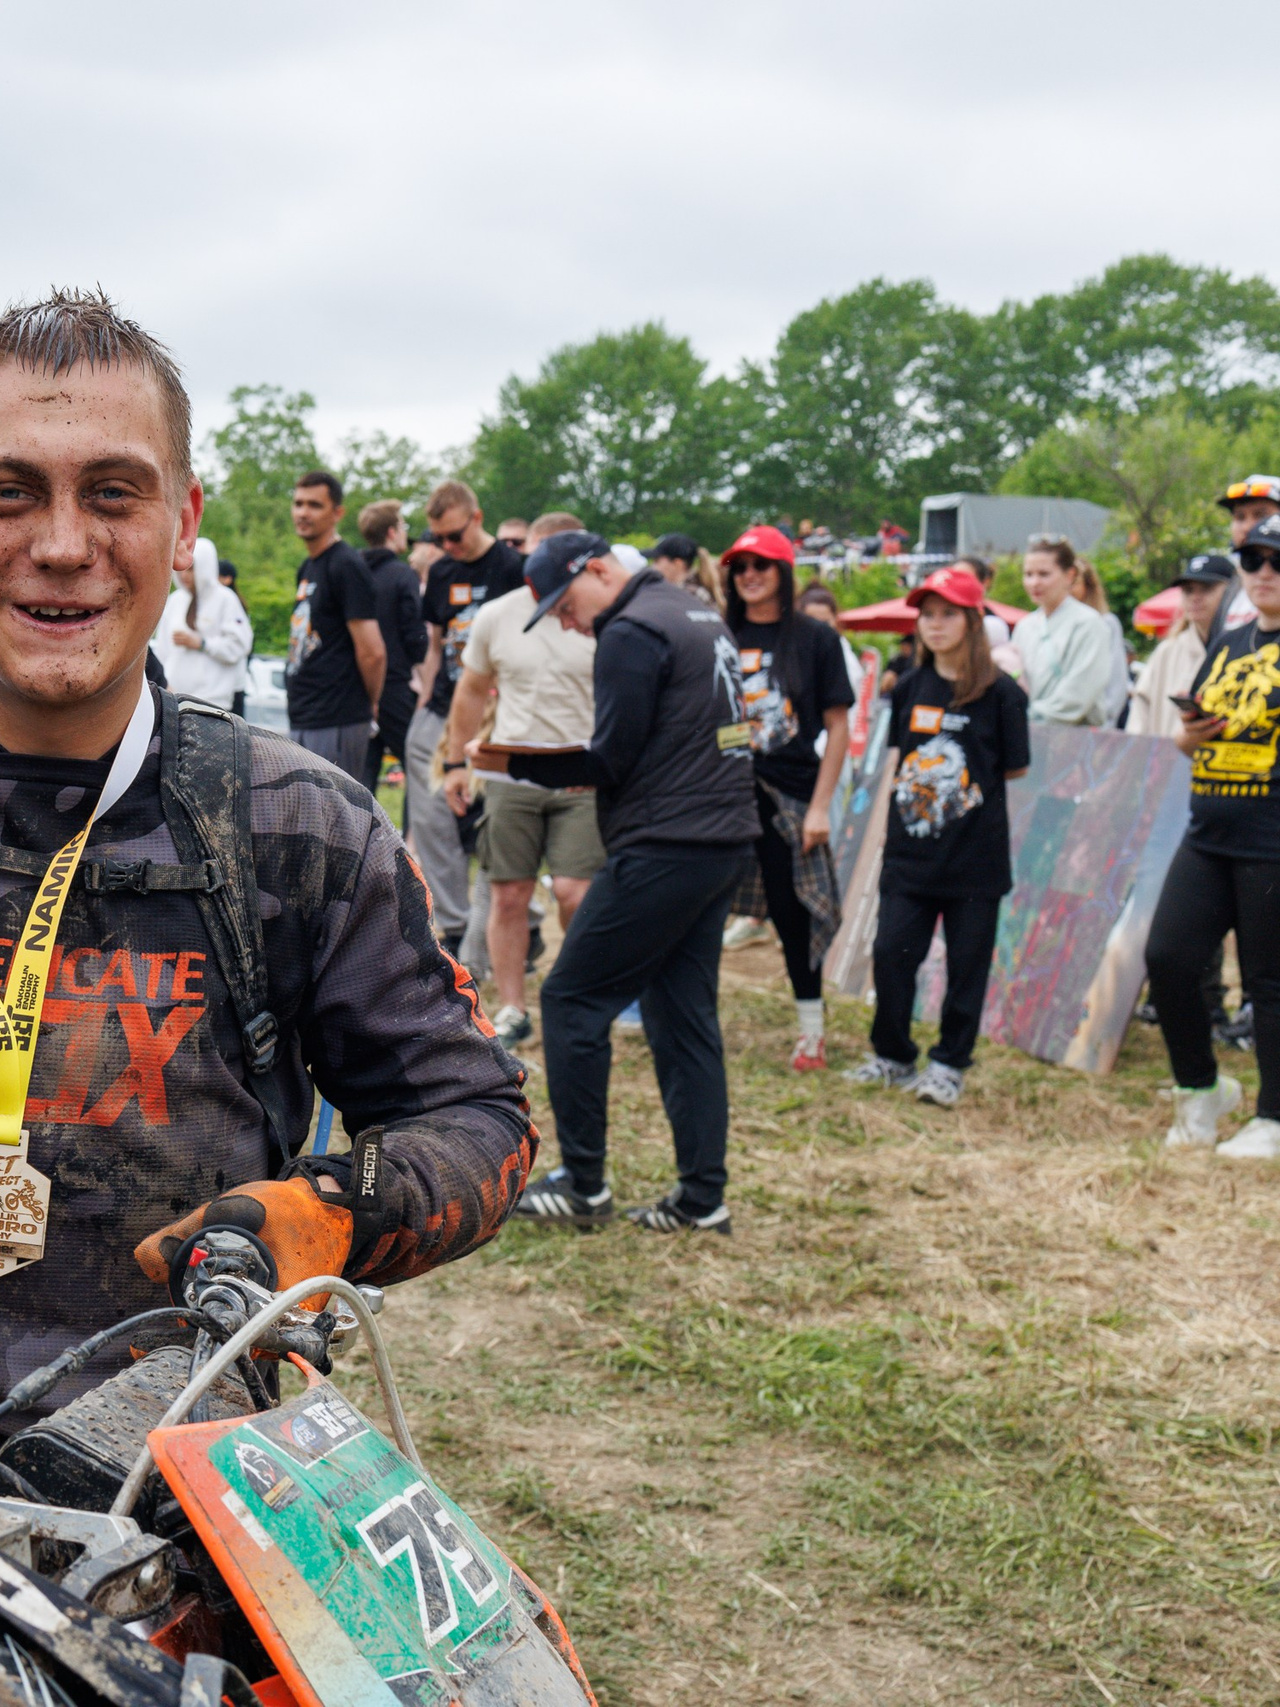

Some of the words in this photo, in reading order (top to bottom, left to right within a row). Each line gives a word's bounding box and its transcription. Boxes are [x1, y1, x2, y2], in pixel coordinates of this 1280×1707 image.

[15, 965, 30, 1009] SAKHALIN
[22, 973, 34, 1010] ENDURO
[28, 974, 41, 1011] TROPHY
